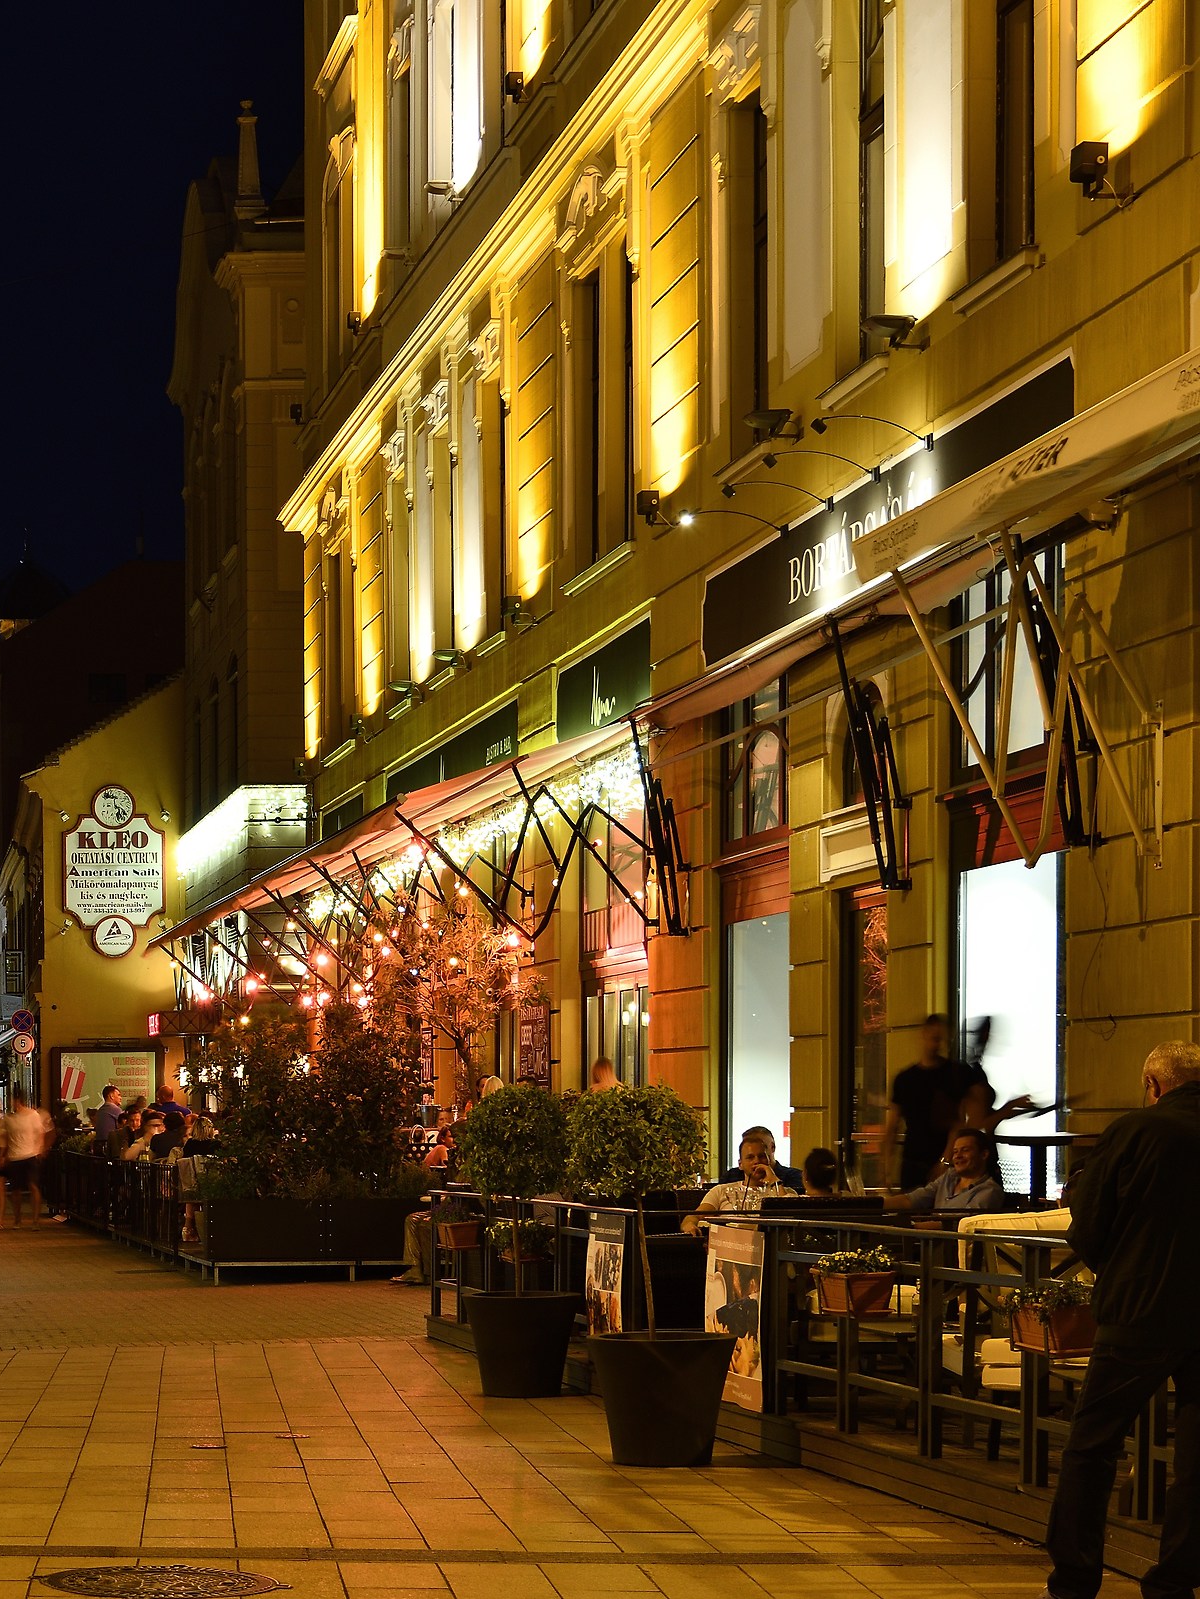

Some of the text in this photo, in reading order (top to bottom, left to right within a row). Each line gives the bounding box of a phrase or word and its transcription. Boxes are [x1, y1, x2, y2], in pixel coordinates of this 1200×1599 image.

[76, 830, 149, 850] KLEO
[71, 850, 158, 864] OKTATÁSI CENTRUM
[66, 866, 160, 877] American Nails
[70, 879, 159, 890] Műkörömalapanyag
[80, 891, 149, 901] kis és nagyker.
[20, 1039, 26, 1048] 5
